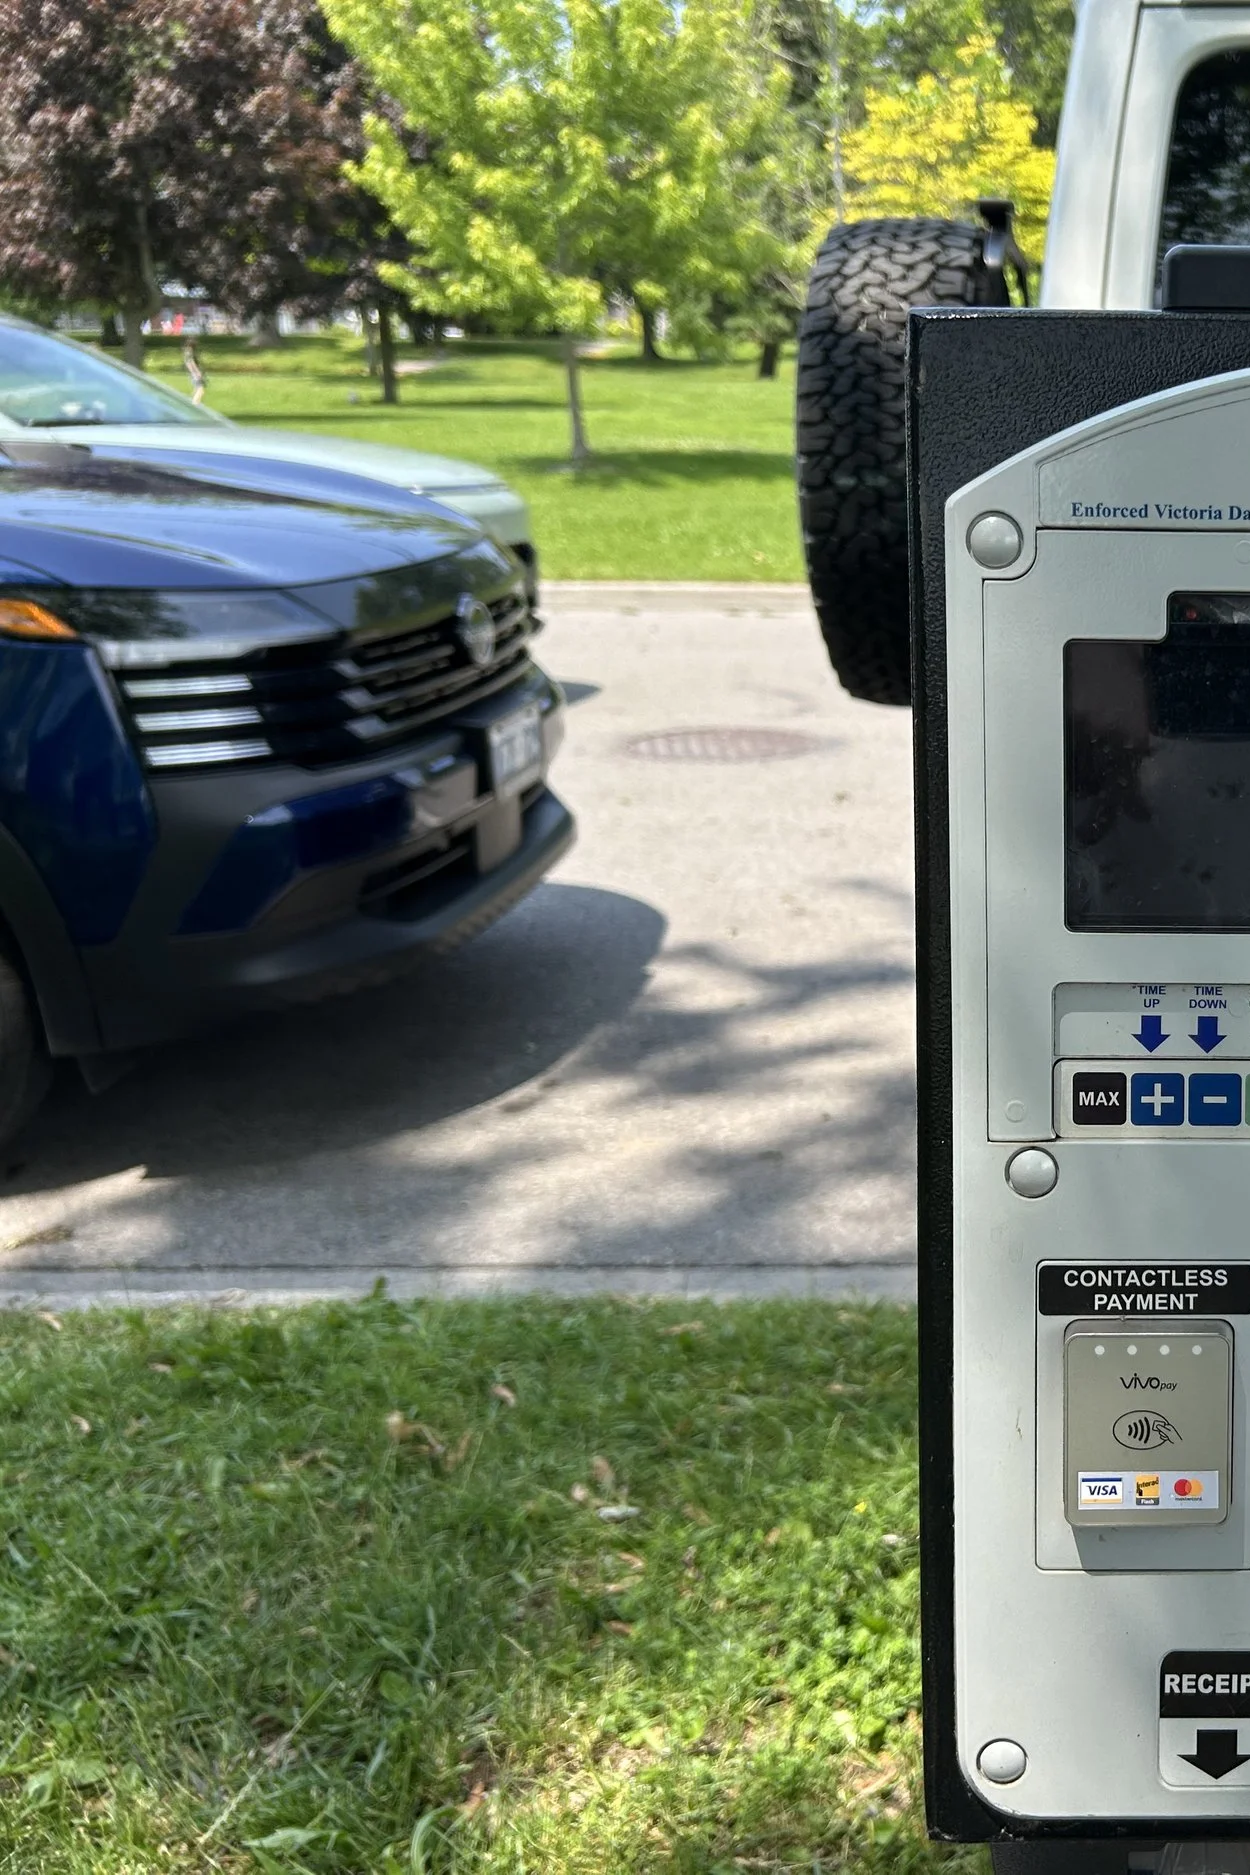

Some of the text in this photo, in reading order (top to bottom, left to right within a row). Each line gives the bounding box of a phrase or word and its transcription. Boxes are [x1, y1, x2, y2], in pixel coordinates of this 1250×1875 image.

[1071, 502, 1148, 519] Enforced
[1154, 504, 1222, 521] Victoria
[1137, 985, 1166, 995] TIME
[1194, 986, 1223, 996] TIME
[1143, 998, 1160, 1009] UP
[1189, 999, 1227, 1009] DOWN
[1079, 1091, 1120, 1106] MAX
[1064, 1269, 1228, 1287] CONTACTLESS
[1094, 1293, 1199, 1311] PAYMENT
[1087, 1485, 1118, 1496] VISA
